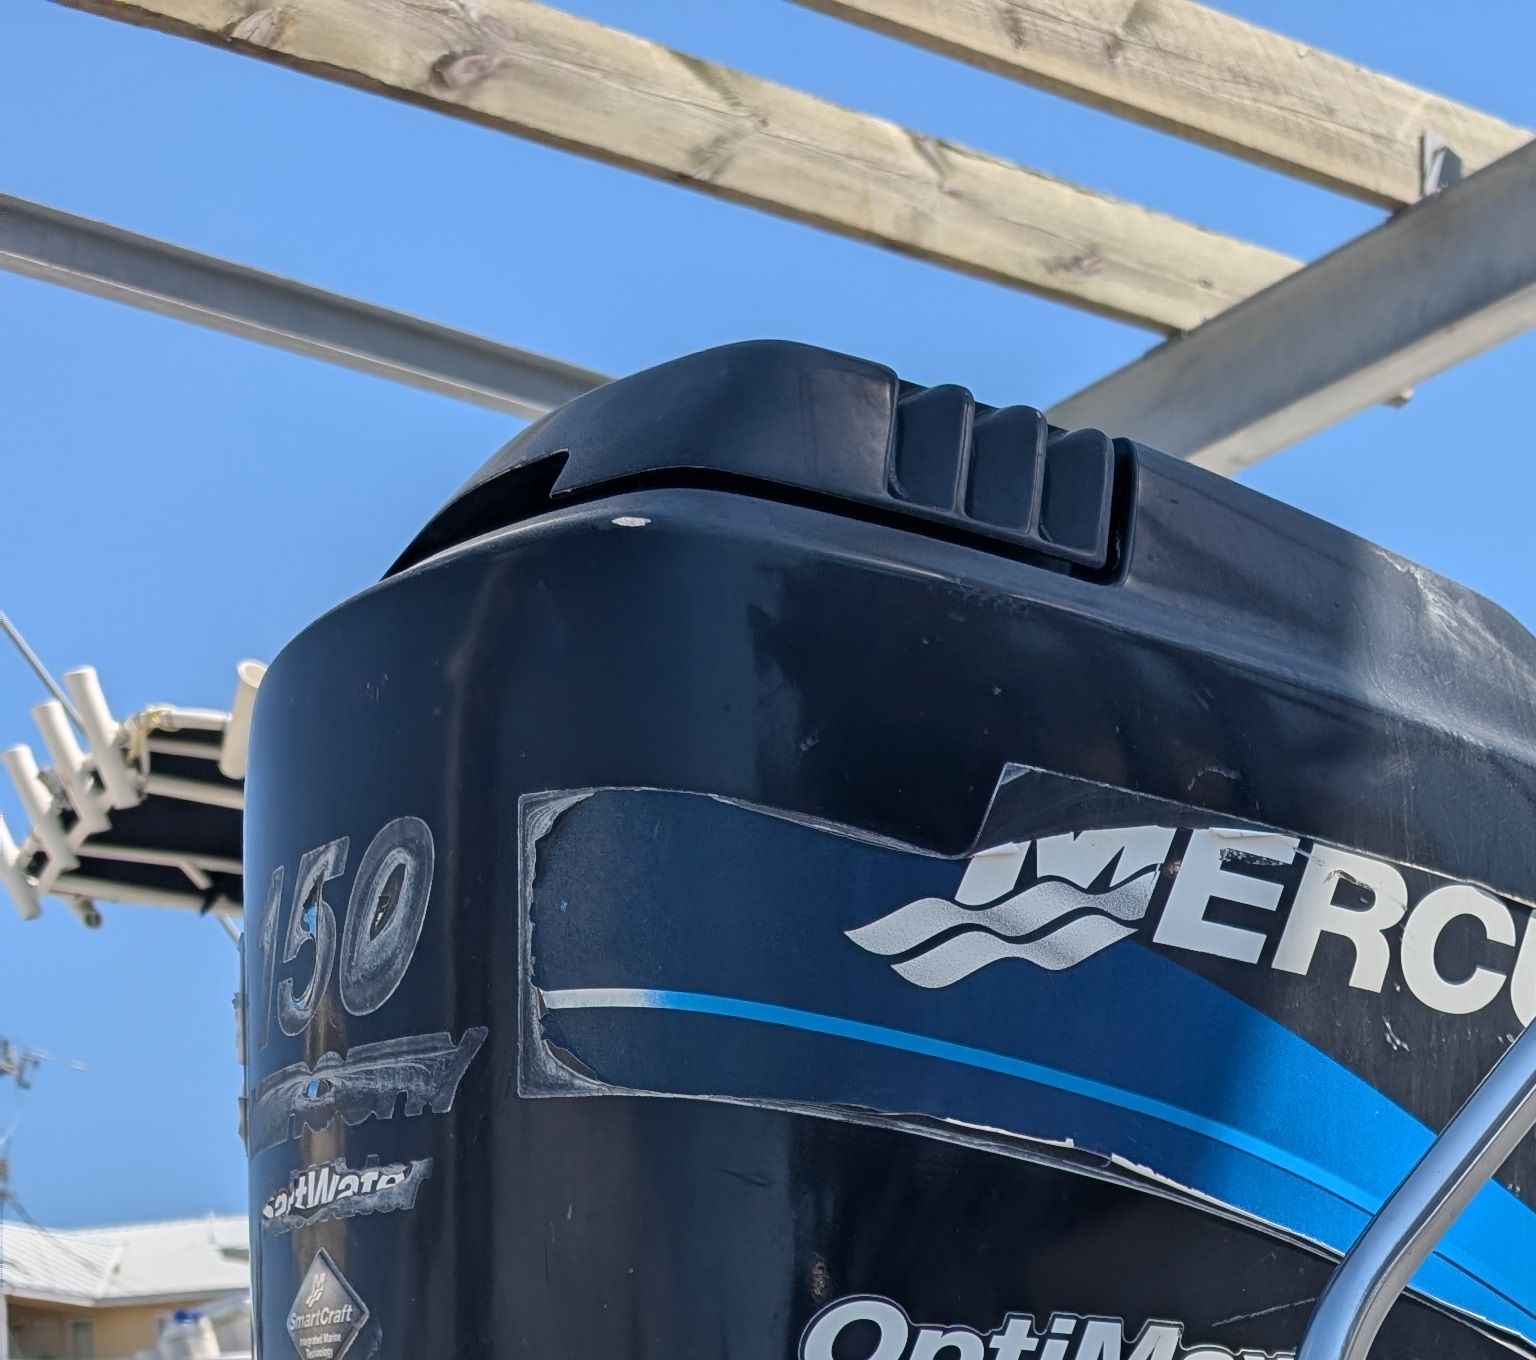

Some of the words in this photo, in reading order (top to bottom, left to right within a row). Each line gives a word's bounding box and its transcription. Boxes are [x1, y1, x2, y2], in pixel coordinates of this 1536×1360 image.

[256, 815, 436, 1051] 150
[262, 1160, 412, 1224] atWate
[288, 1303, 353, 1331] SmartCraft
